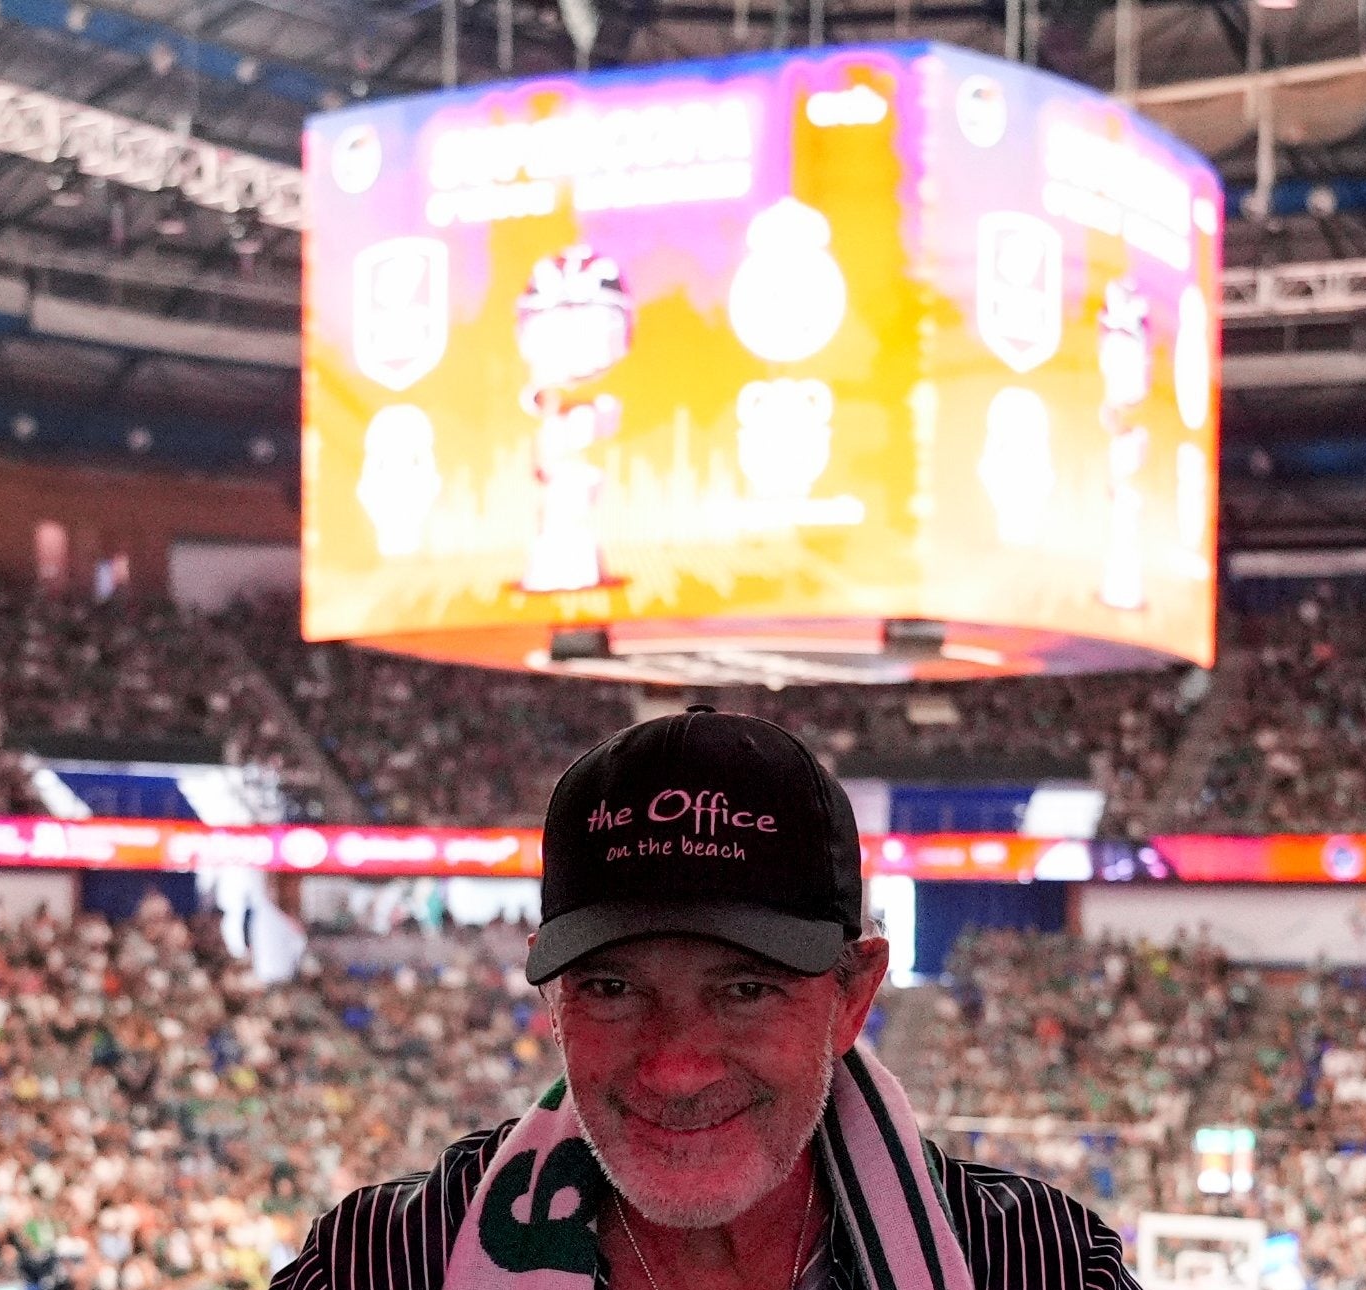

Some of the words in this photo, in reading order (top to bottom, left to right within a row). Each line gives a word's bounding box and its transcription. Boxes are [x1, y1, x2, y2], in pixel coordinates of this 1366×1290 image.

[587, 799, 633, 834] the
[647, 788, 779, 837] Office
[606, 844, 632, 863] on
[638, 838, 672, 857] the
[681, 835, 747, 862] beach
